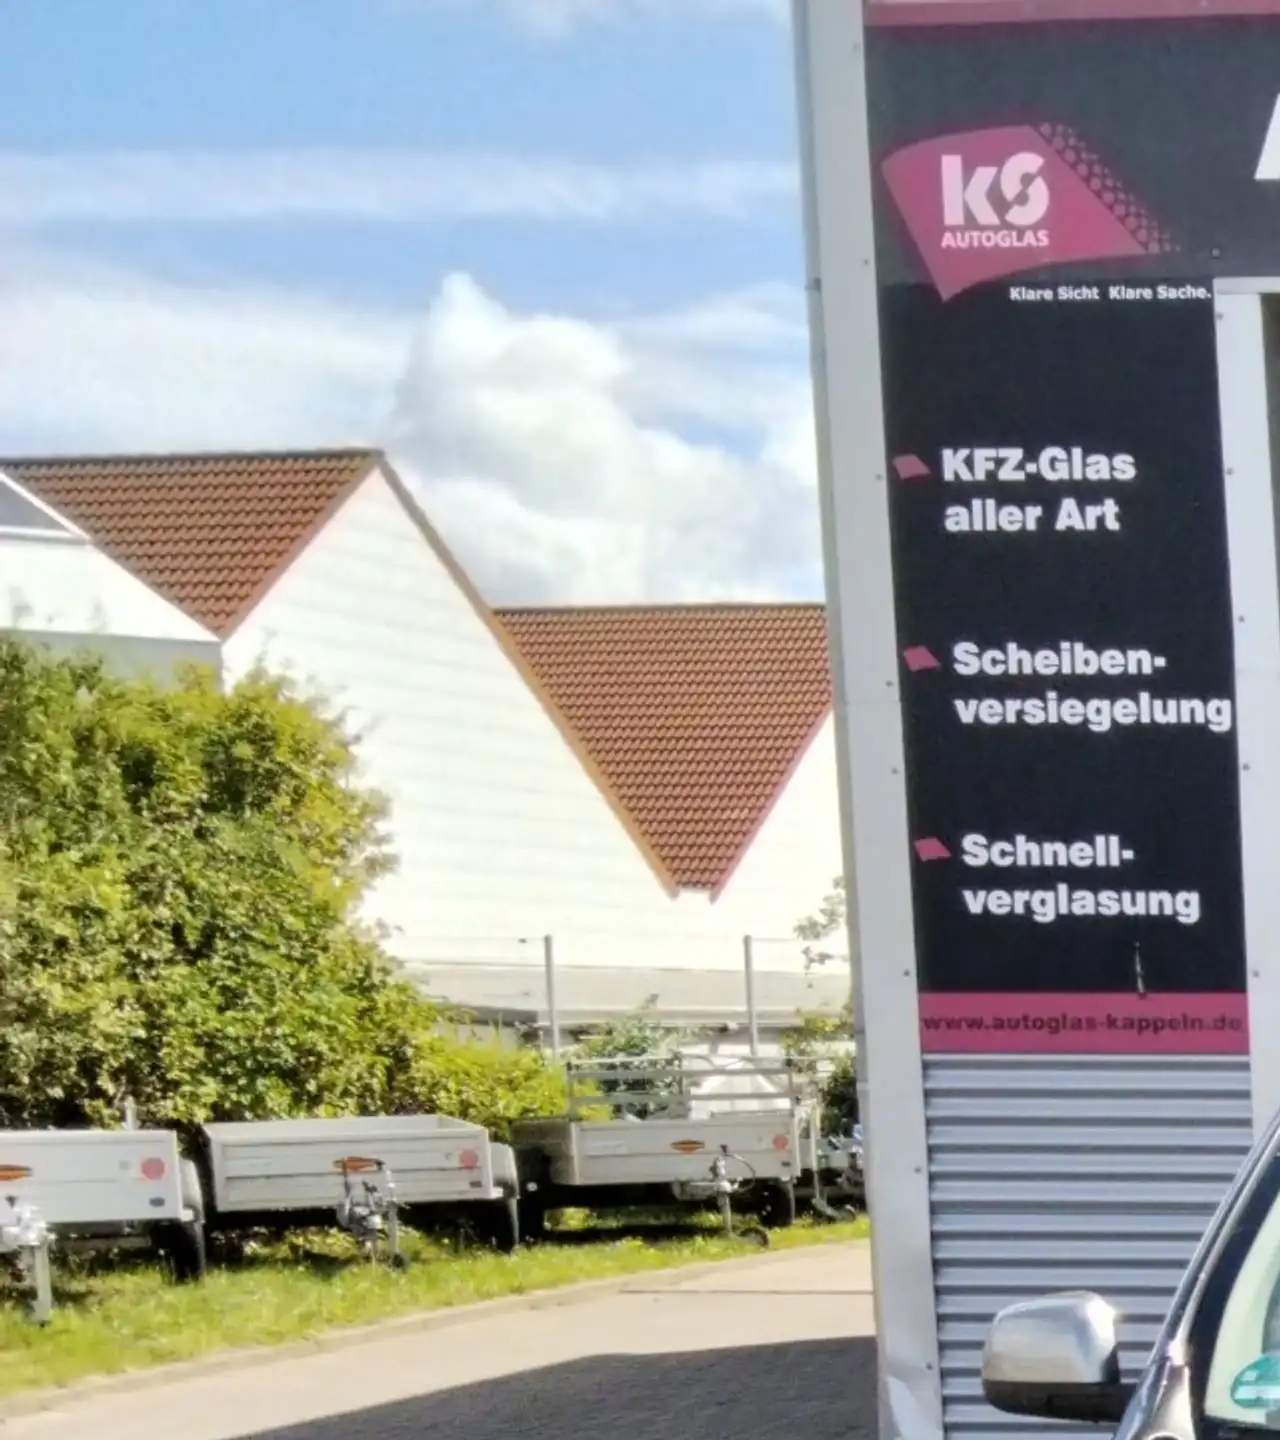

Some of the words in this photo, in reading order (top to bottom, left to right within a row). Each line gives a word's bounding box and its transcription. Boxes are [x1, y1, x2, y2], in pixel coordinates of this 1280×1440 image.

[941, 229, 1049, 248] AUTOGLAS
[1009, 286, 1054, 301] Klare
[1108, 285, 1153, 300] Klare
[1156, 284, 1212, 300] Sache.
[941, 446, 1137, 482] KFZ-Glas
[944, 498, 1043, 532] aller
[1055, 497, 1120, 531] Art
[953, 641, 1166, 676] Scheiben-
[953, 691, 1232, 733] versiegelung
[962, 833, 1134, 868] Schnell-
[962, 882, 1200, 924] verglasung
[922, 1013, 1243, 1036] www.autoglas-kappeln.de
